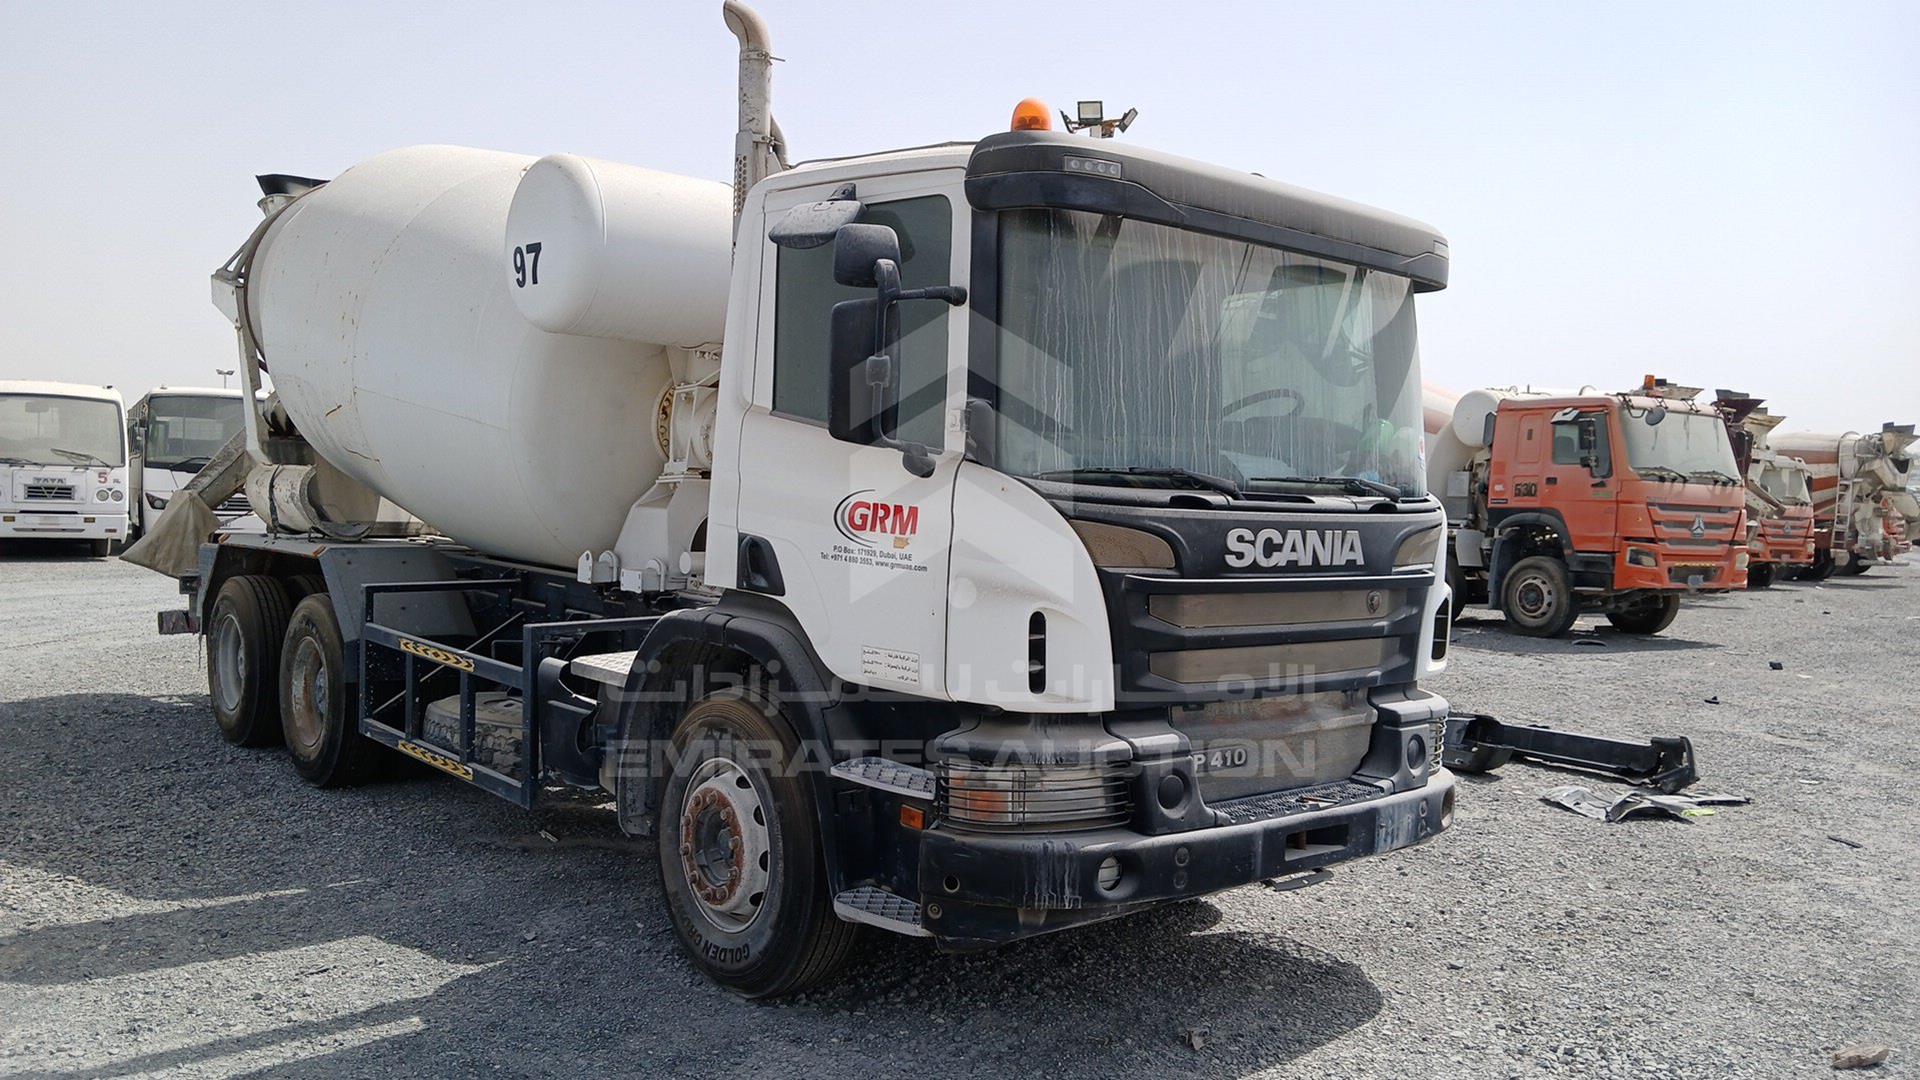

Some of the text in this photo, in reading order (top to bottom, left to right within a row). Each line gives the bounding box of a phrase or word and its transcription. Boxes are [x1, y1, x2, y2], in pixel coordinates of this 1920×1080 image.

[513, 241, 542, 288] 97
[848, 501, 919, 535] GRM
[898, 552, 913, 561] UAE
[1224, 528, 1365, 568] SCANIA
[1192, 748, 1247, 772] P 410
[701, 940, 751, 964] GOLDEN
